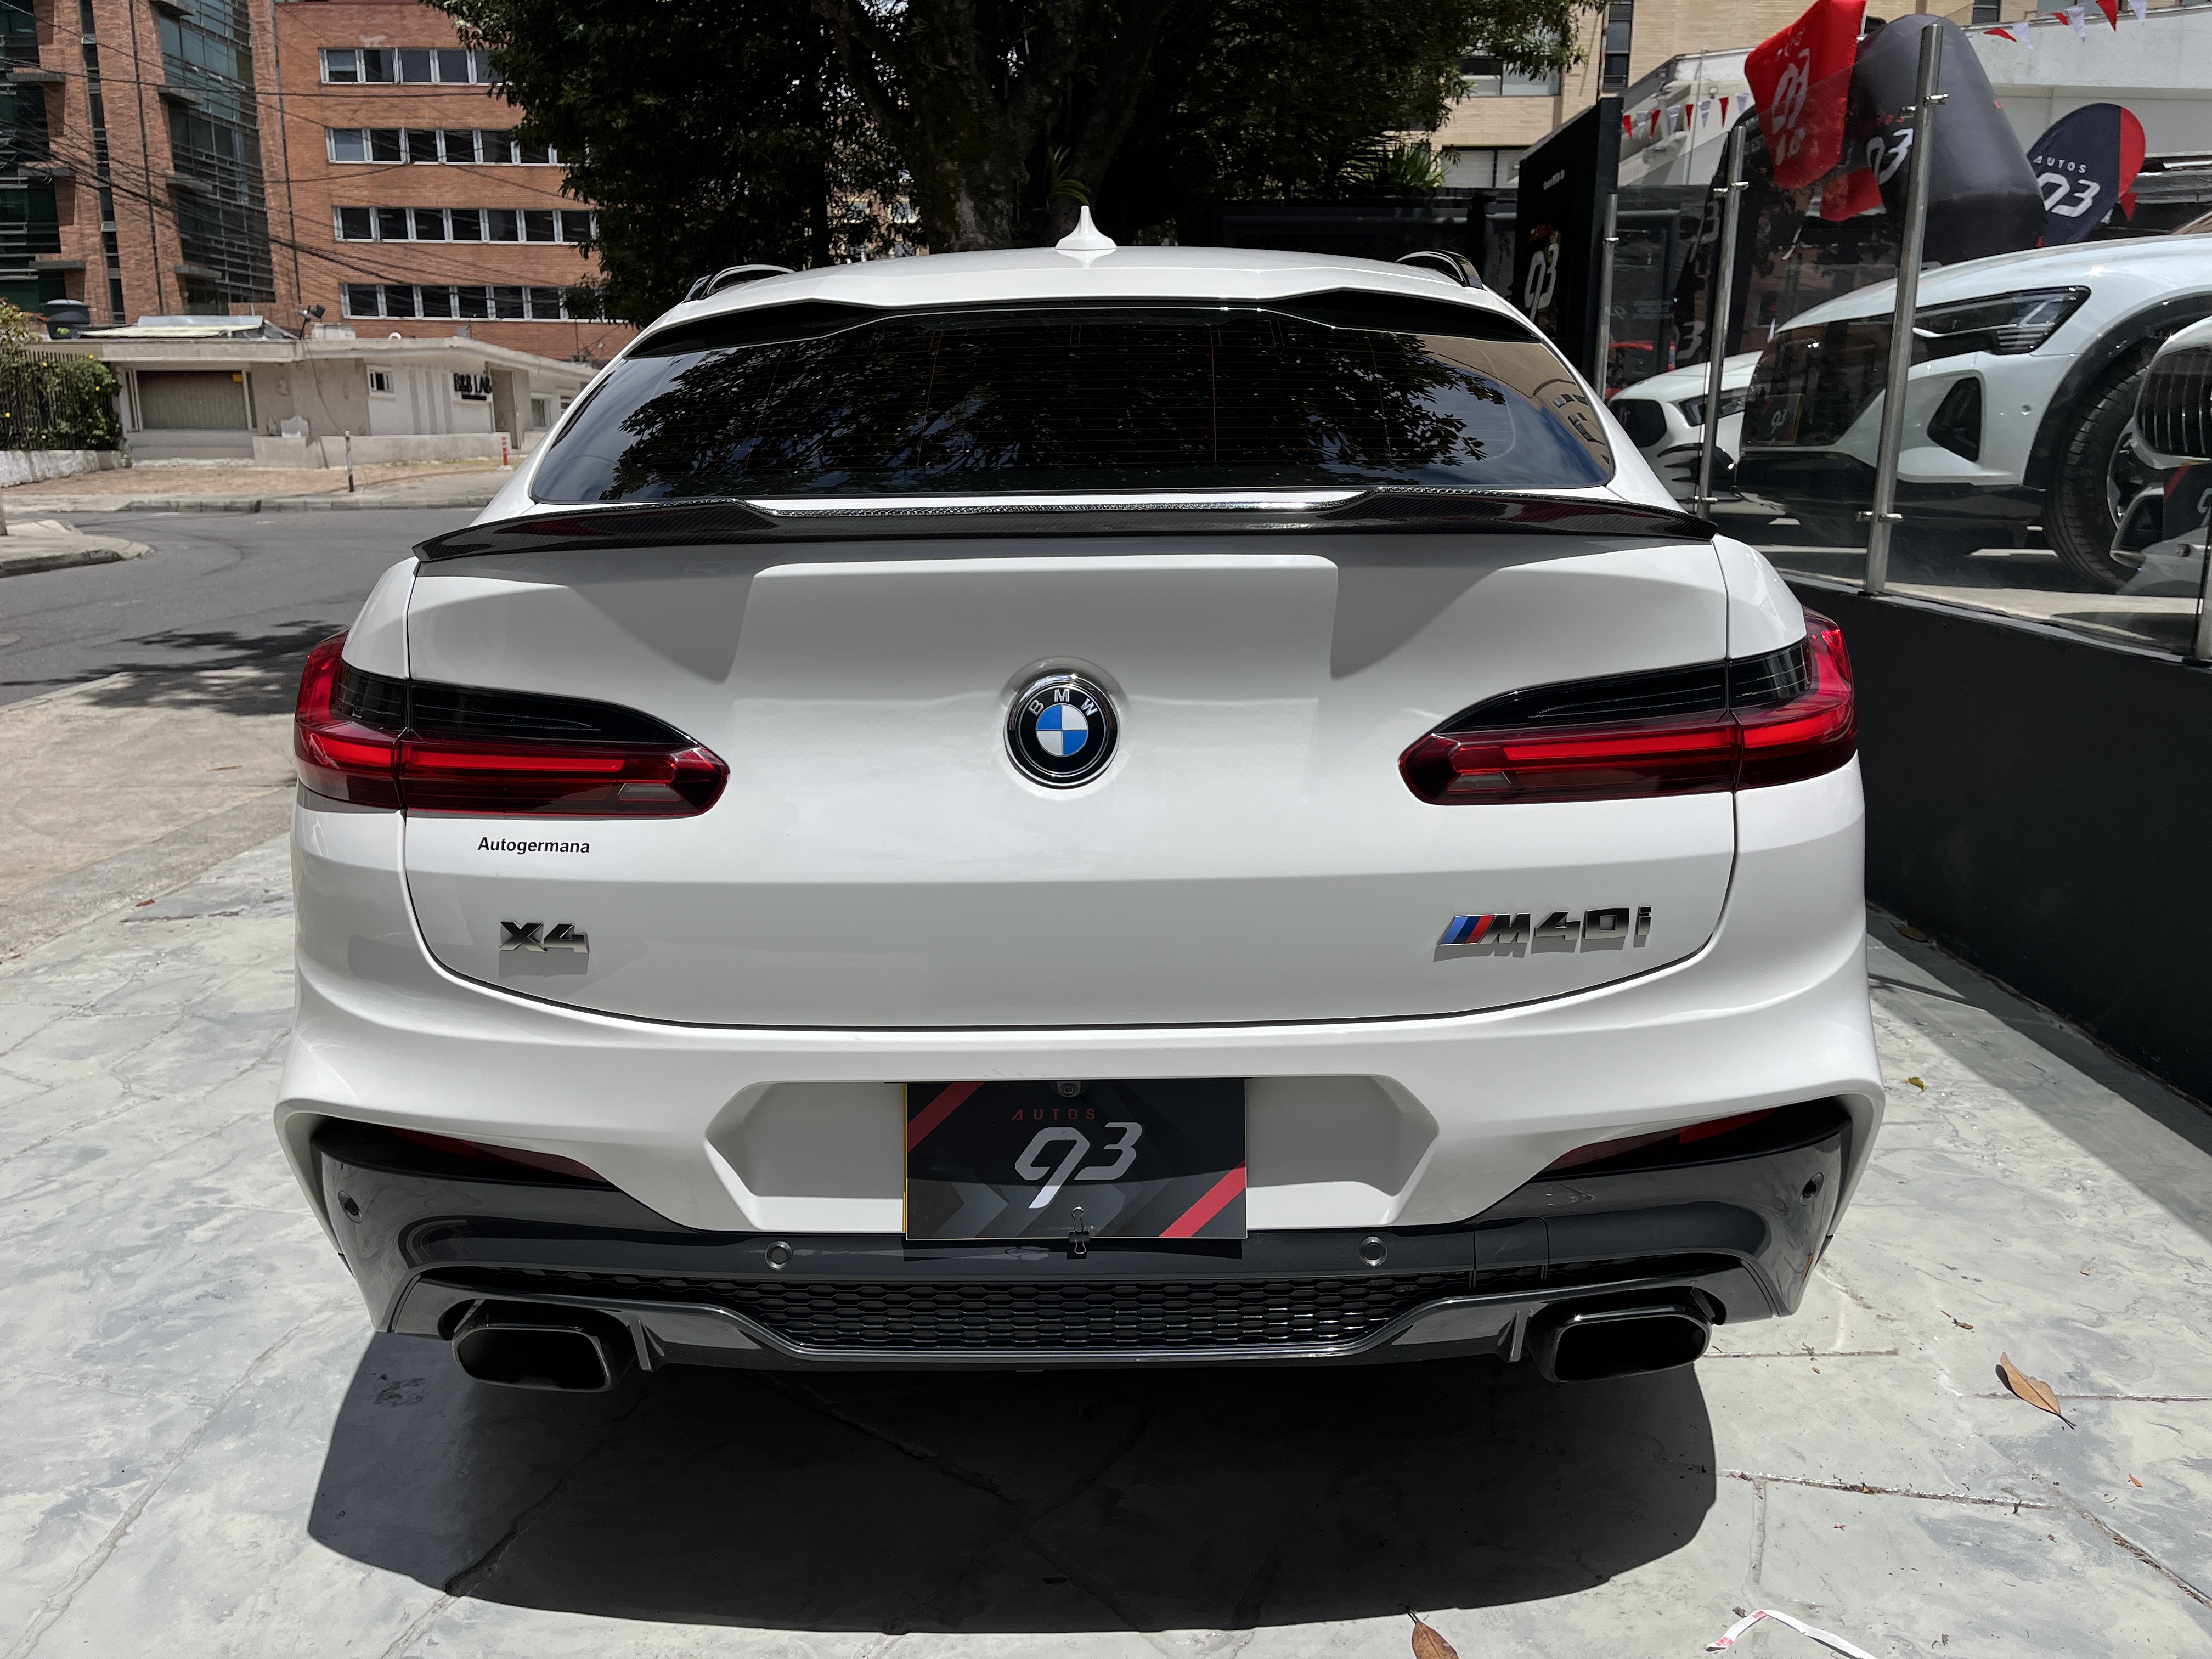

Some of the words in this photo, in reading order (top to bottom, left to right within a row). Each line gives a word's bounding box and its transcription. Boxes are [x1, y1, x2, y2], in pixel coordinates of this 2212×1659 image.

[2033, 155, 2087, 173] AUTOS
[1028, 689, 1098, 716] BMW
[477, 837, 590, 855] Autogermana
[499, 919, 590, 953] X4
[1478, 904, 1652, 944] M40i
[1011, 1108, 1097, 1121] AUTOS
[1014, 1122, 1144, 1209] 93
